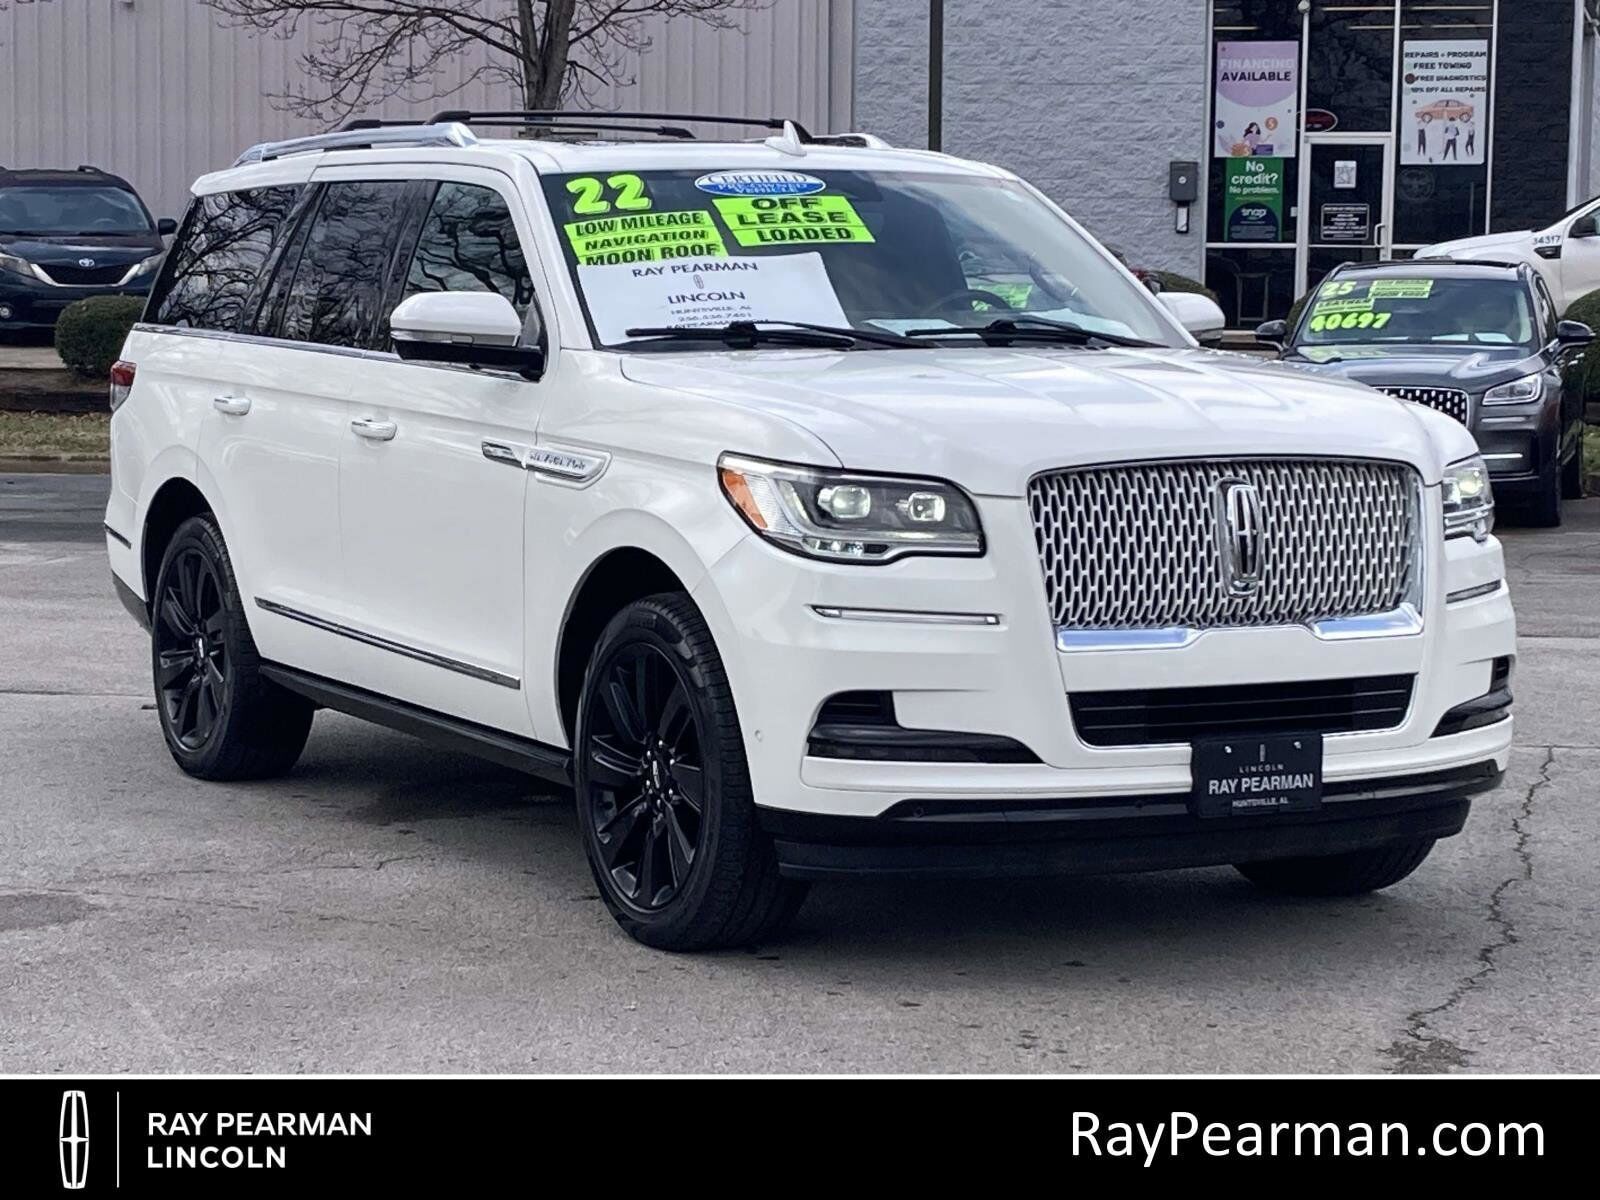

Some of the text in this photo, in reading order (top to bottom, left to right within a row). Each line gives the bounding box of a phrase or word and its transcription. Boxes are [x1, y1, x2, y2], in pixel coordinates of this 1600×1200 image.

[1220, 71, 1292, 81] AVAILABLE
[1245, 160, 1265, 172] No
[707, 174, 808, 184] CERTIFIED
[1231, 172, 1279, 185] credit?
[566, 174, 652, 214] 22
[1229, 185, 1242, 193] No
[751, 197, 822, 210] OFF
[736, 211, 849, 225] LEASE
[1241, 207, 1267, 218] snap
[575, 212, 704, 237] LOW MILEAGE
[584, 229, 709, 251] NAVIGATION
[756, 227, 855, 242] LOADED
[585, 243, 720, 266] MOON ROOF
[632, 262, 759, 278] RAY PEARMAN
[1321, 281, 1357, 297] 25
[667, 291, 746, 305] LINCOLN
[1310, 312, 1392, 332] 40697
[1239, 764, 1284, 773] LINCOLN
[1208, 773, 1314, 795] RAY PEARMAN
